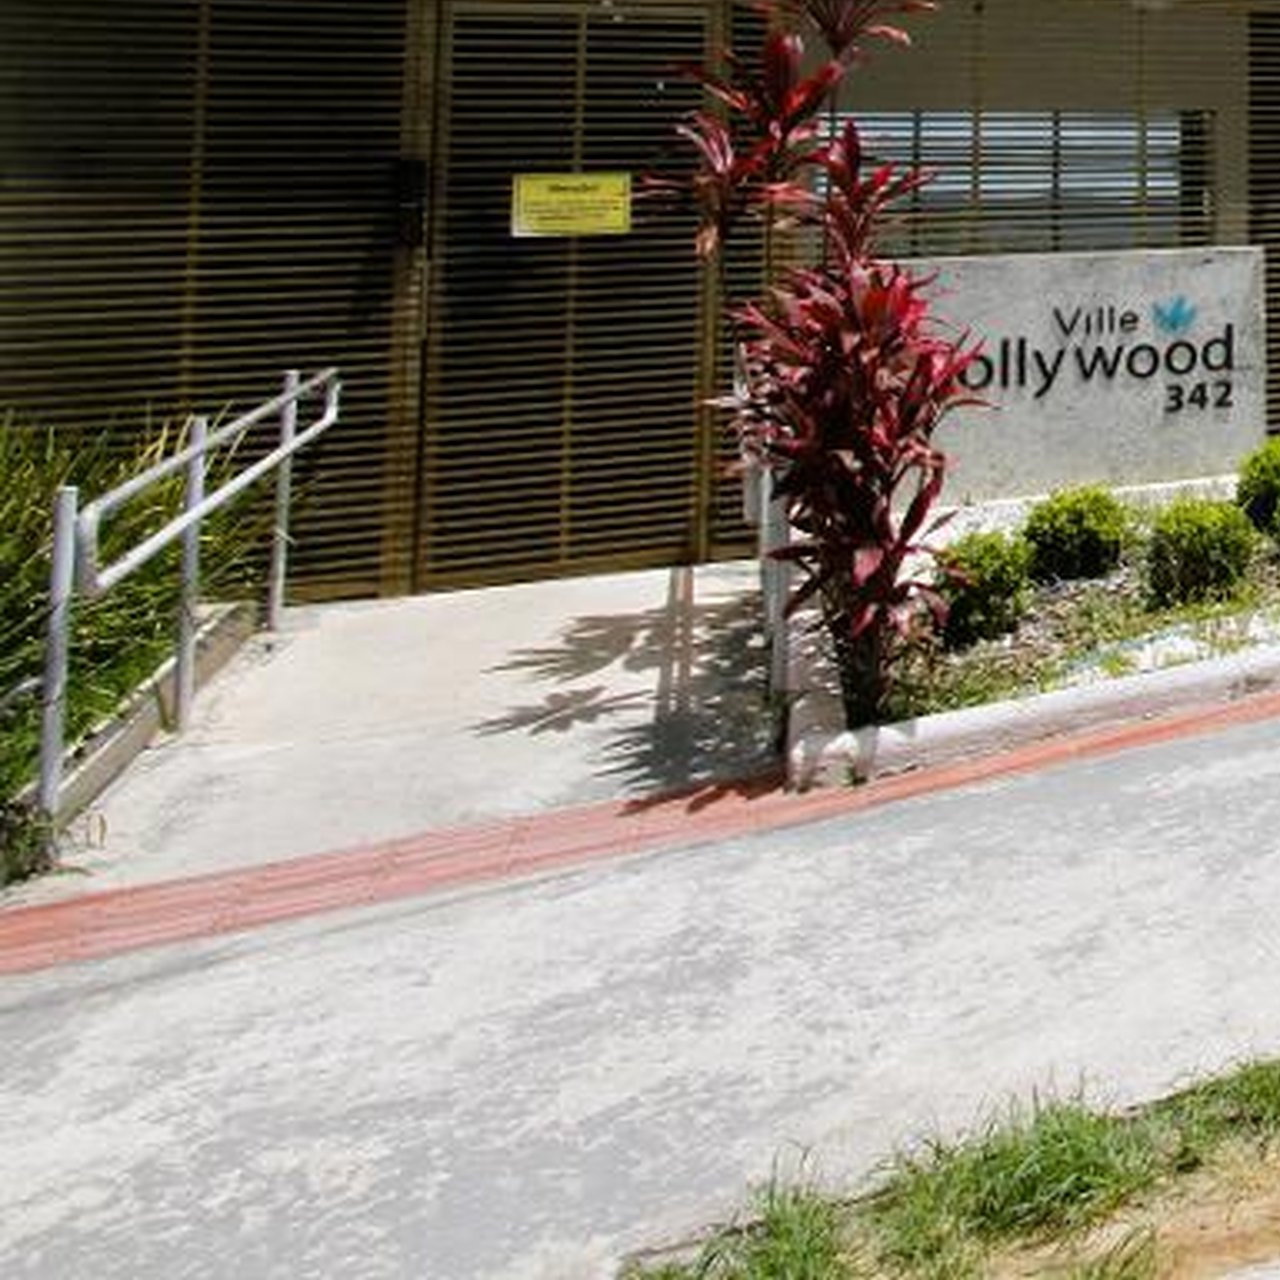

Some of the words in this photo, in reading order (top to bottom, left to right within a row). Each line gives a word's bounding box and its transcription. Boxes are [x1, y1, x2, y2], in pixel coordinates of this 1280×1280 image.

[1052, 306, 1139, 337] Ville
[957, 323, 1235, 398] ollywood
[1163, 382, 1233, 413] 342
